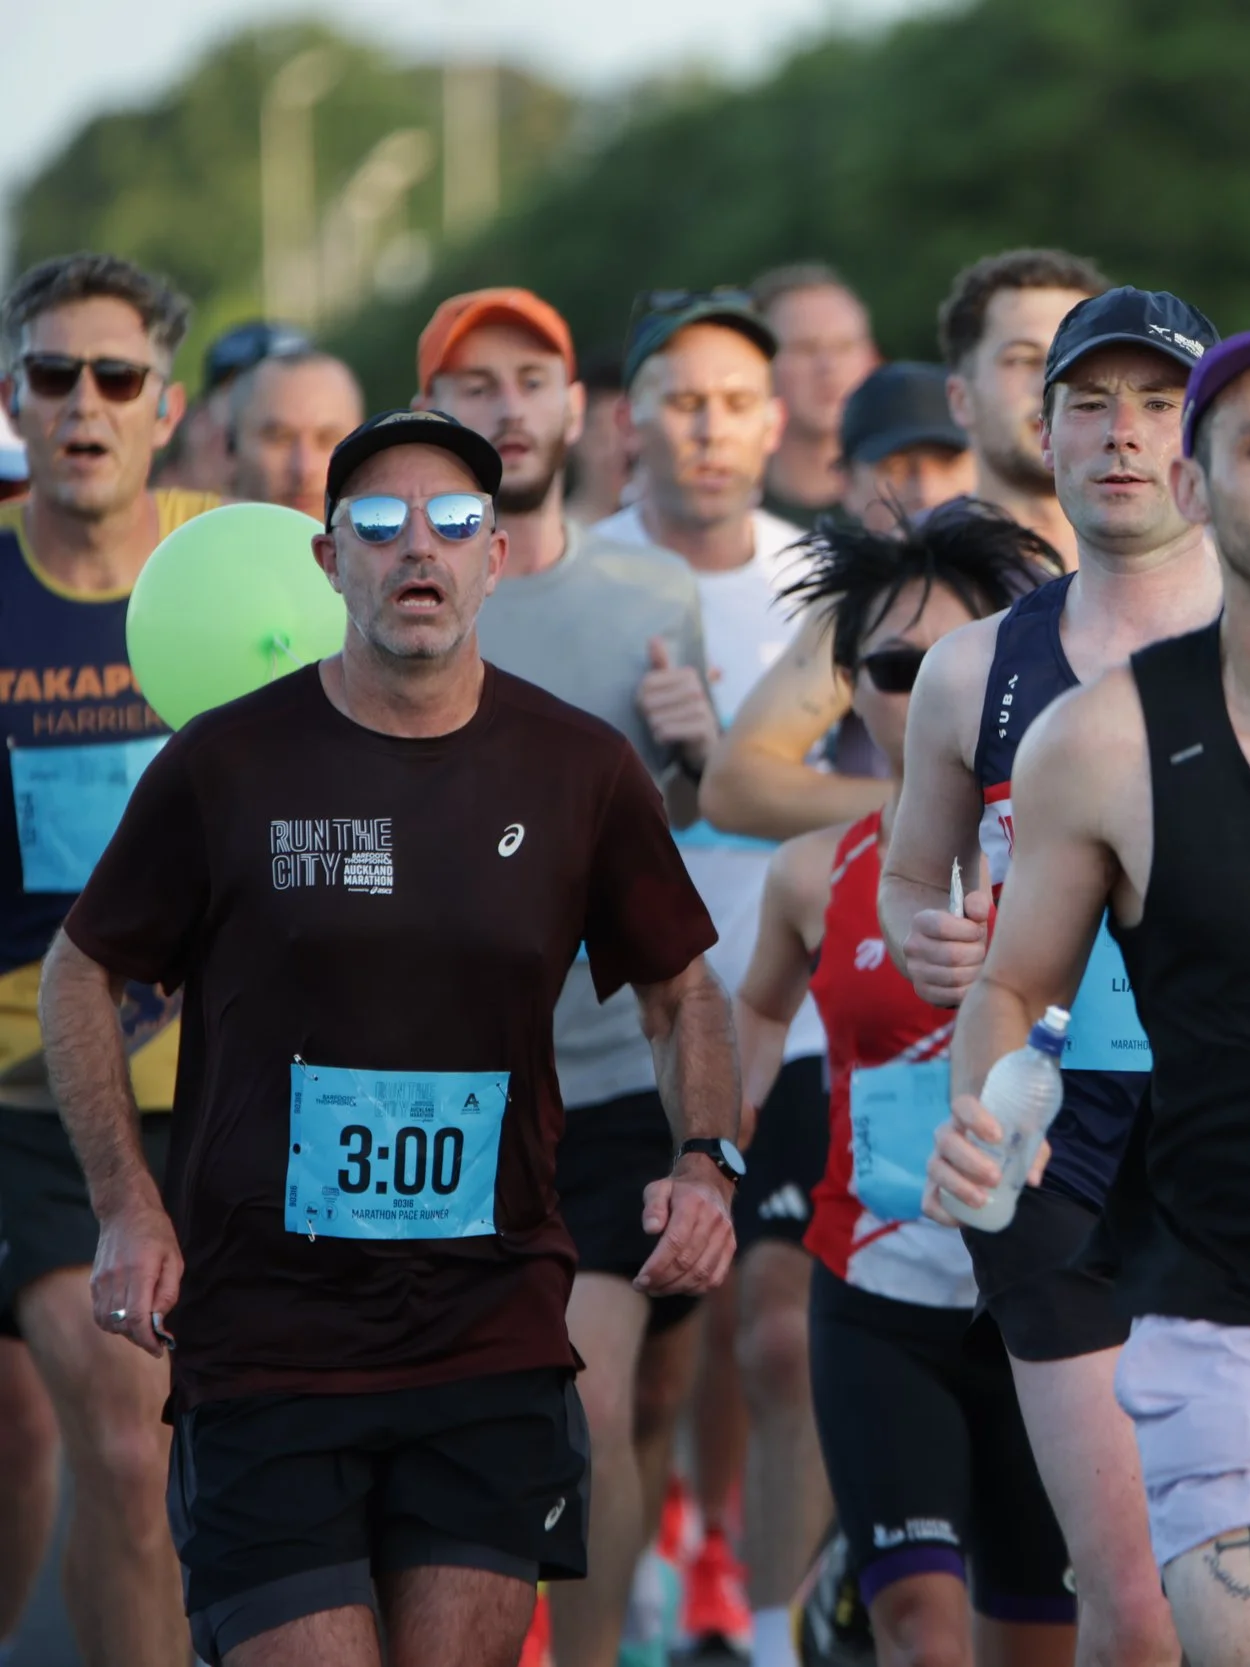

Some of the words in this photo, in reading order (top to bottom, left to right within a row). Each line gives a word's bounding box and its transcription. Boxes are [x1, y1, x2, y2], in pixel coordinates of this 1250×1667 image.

[0, 664, 141, 702] TAKAP
[271, 820, 330, 853] RUN
[332, 818, 393, 851] THE
[272, 853, 341, 890] CITY
[343, 865, 393, 876] AUCKLAND
[343, 875, 393, 886] MARATHON
[1111, 1040, 1149, 1050] MARATHO
[338, 1124, 464, 1195] 3:00
[393, 1199, 414, 1208] 90316
[352, 1208, 396, 1220] MARATHON
[399, 1209, 418, 1220] PACE
[419, 1208, 449, 1220] RUNNER
